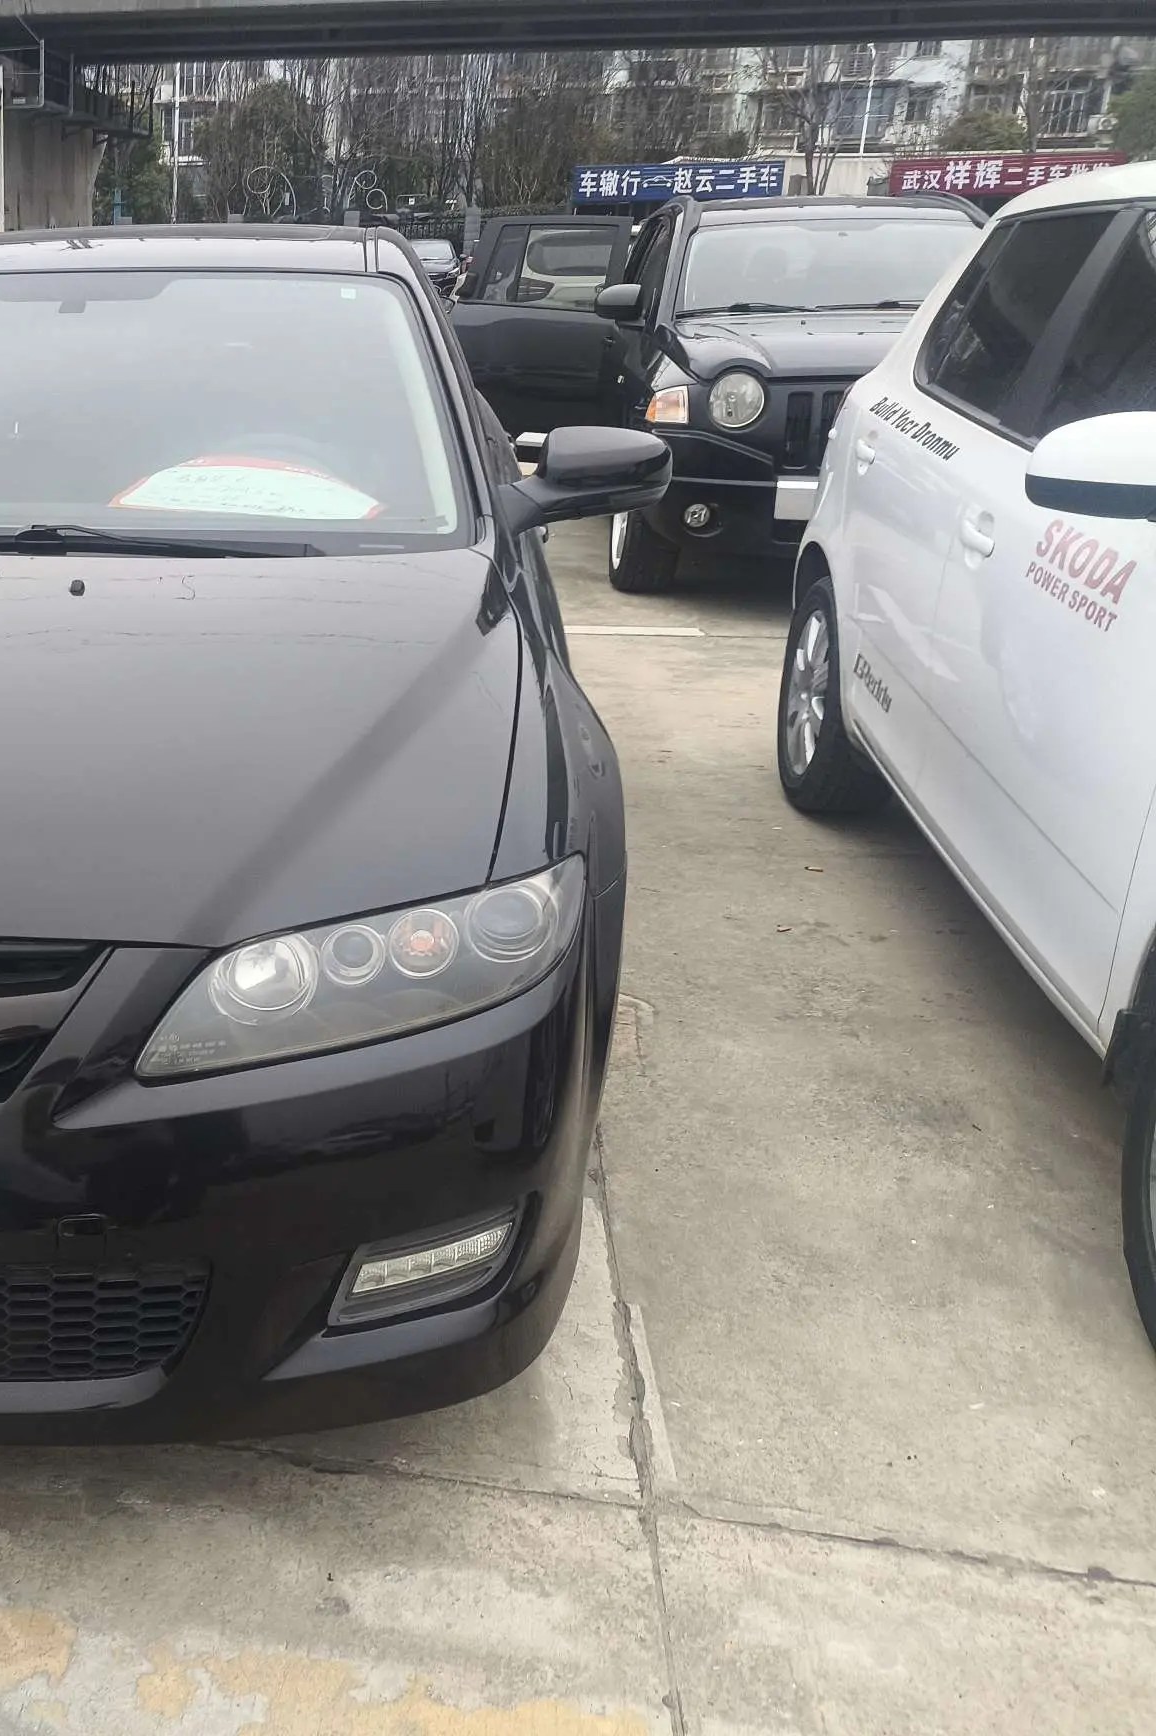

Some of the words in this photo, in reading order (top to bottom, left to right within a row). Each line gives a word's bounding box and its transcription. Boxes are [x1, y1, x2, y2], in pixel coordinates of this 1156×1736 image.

[579, 170, 641, 197] 车辙行
[673, 165, 779, 195] 赵云二手车
[1025, 561, 1070, 603] POWER
[1068, 590, 1118, 633] SPORT
[1035, 518, 1138, 605] SKODA
